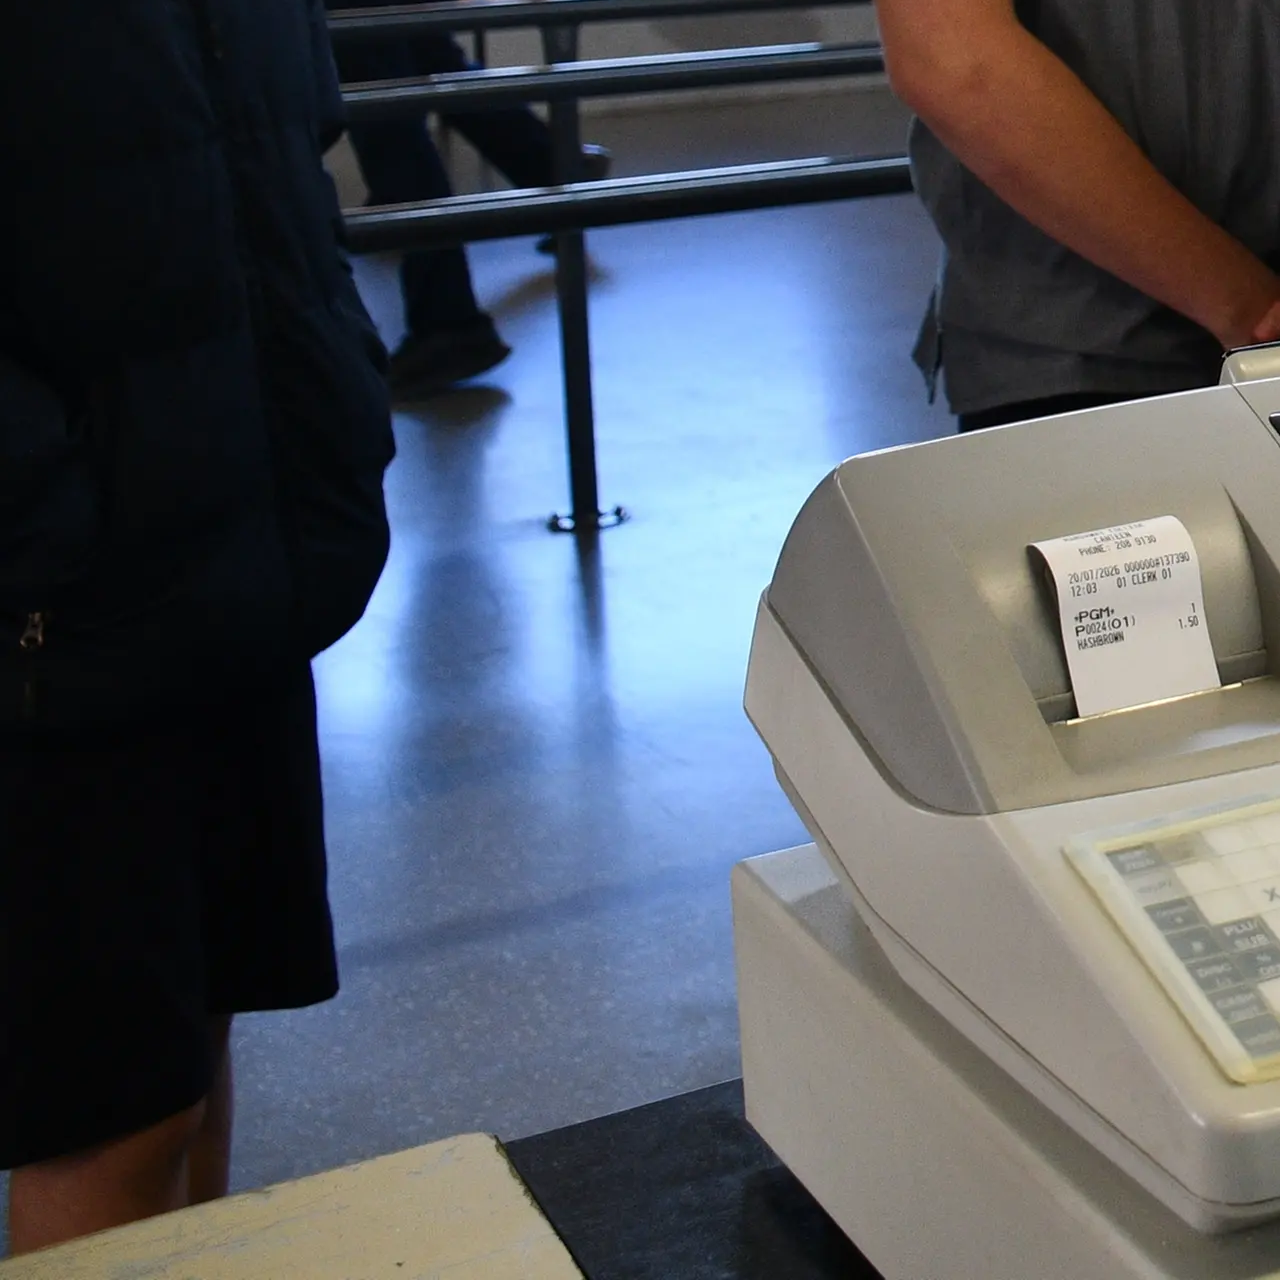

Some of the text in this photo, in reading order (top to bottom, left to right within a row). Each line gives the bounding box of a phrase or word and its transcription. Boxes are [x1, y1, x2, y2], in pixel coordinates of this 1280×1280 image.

[1094, 532, 1132, 544] CANTEEN
[1115, 539, 1132, 550] 208
[1135, 534, 1157, 546] 9130
[1068, 566, 1120, 585] 20/07/2026
[1071, 567, 1172, 598] 12:03 01 CLERK 01
[1178, 615, 1199, 629] 1.50
[1077, 631, 1125, 650] HASHBROWN
